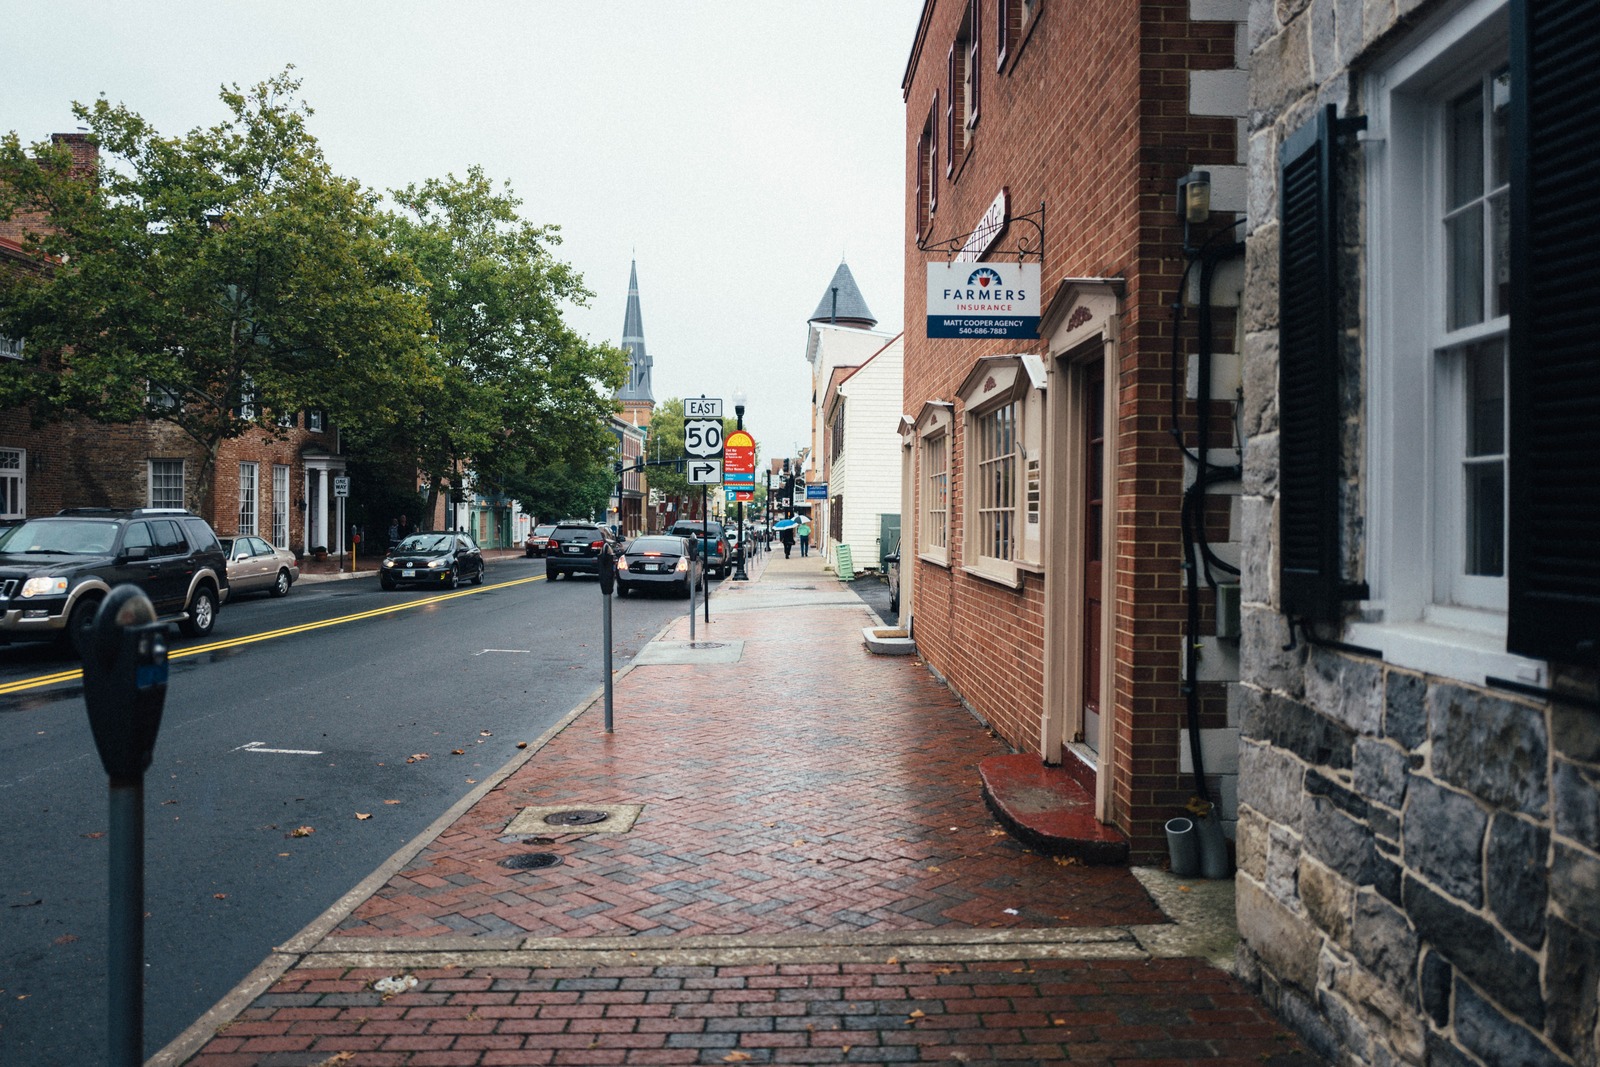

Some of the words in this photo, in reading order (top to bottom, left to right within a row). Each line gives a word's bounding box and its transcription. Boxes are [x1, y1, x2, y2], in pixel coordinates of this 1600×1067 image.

[943, 289, 1026, 300] FARMERS
[956, 304, 1013, 312] INSURANCE
[943, 319, 963, 327] MATT
[963, 319, 994, 327] COOPER
[994, 319, 1024, 327] AGENCY
[958, 327, 1008, 335] 540-686-7883
[690, 402, 716, 414] EAST
[688, 427, 720, 448] 50
[728, 492, 734, 501] P
